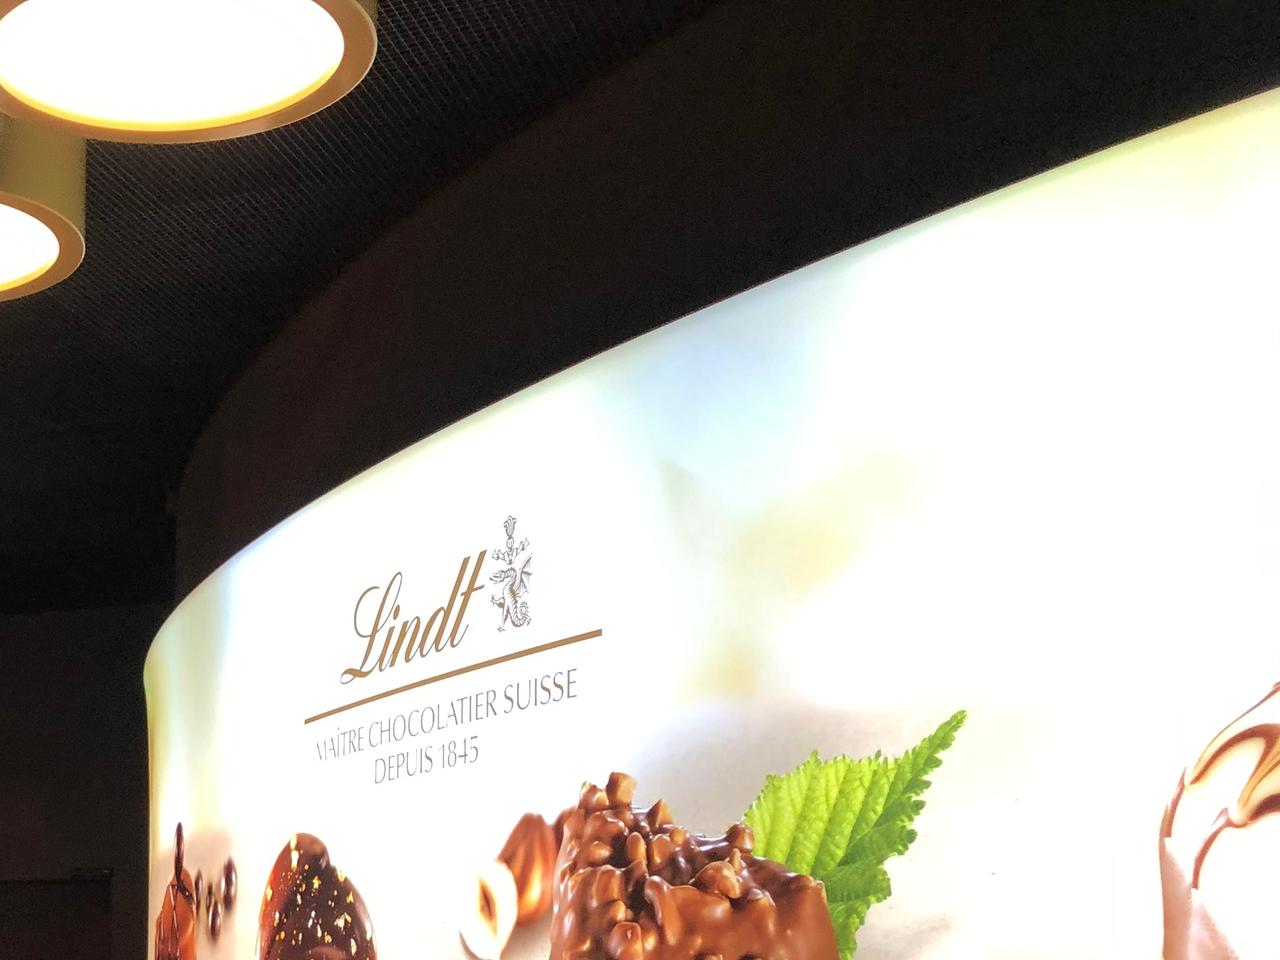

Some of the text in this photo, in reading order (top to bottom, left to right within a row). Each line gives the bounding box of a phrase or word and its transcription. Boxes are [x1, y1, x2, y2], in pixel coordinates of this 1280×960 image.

[340, 550, 487, 685] Lindt
[368, 689, 497, 748] CHOCOLATIER
[503, 668, 577, 713] SUISSE
[374, 736, 479, 784] DEPUIS 1845
